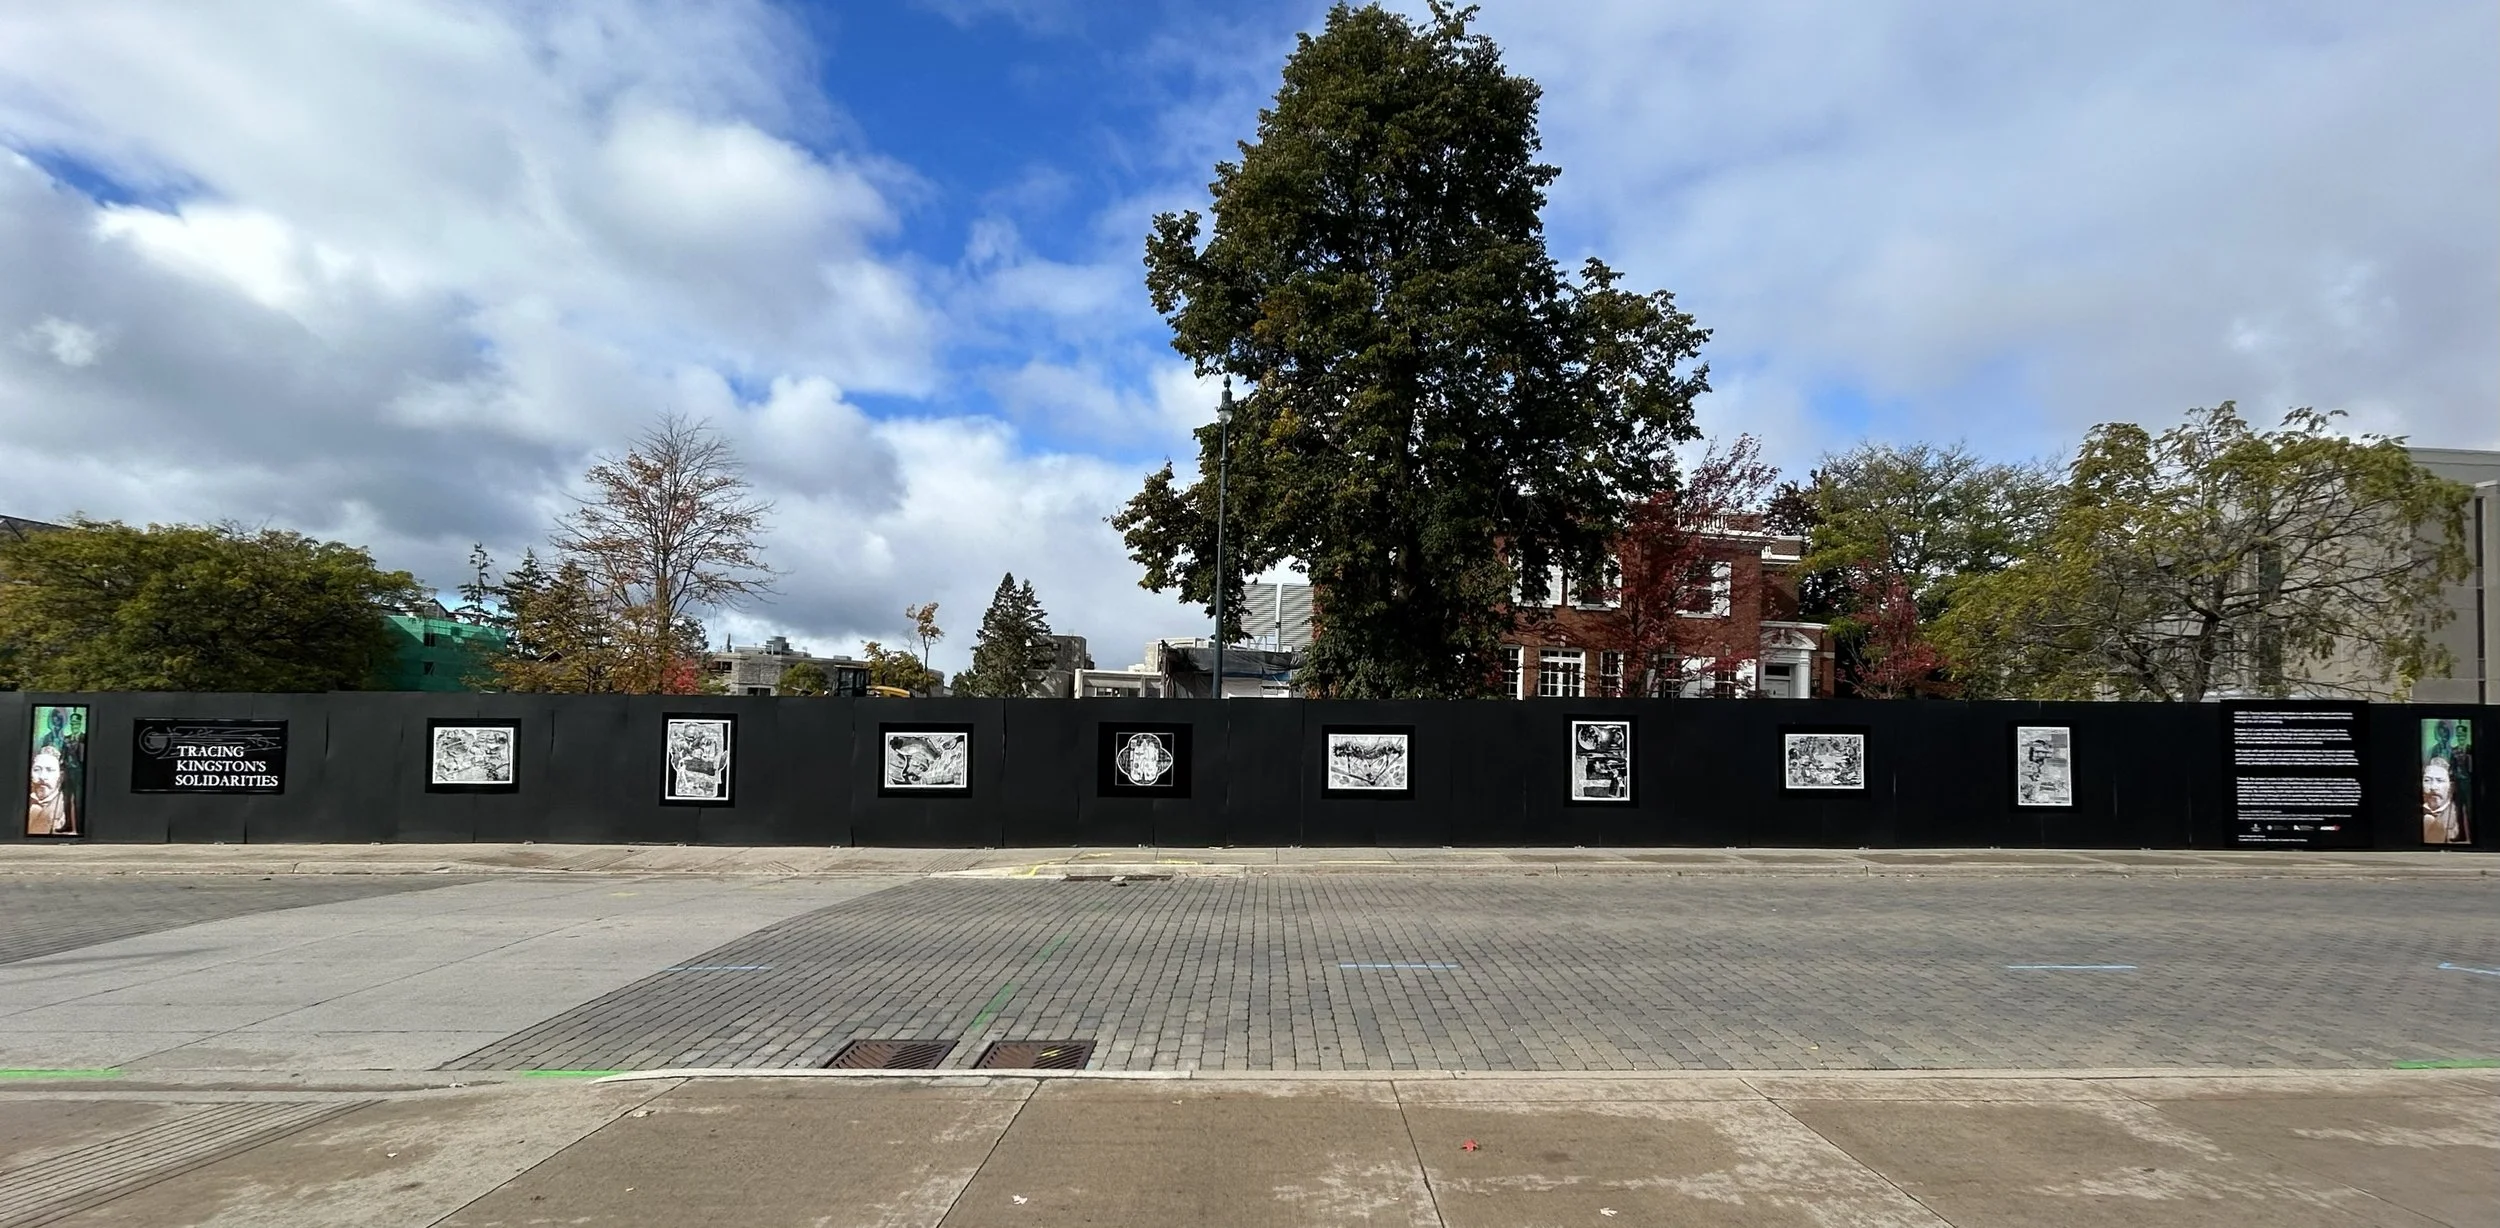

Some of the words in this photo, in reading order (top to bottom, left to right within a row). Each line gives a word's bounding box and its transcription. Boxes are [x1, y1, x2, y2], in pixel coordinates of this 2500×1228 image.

[176, 746, 245, 758] TRACING
[176, 760, 267, 772] KINGSTON'S
[175, 774, 279, 787] SOLIDARITIES
